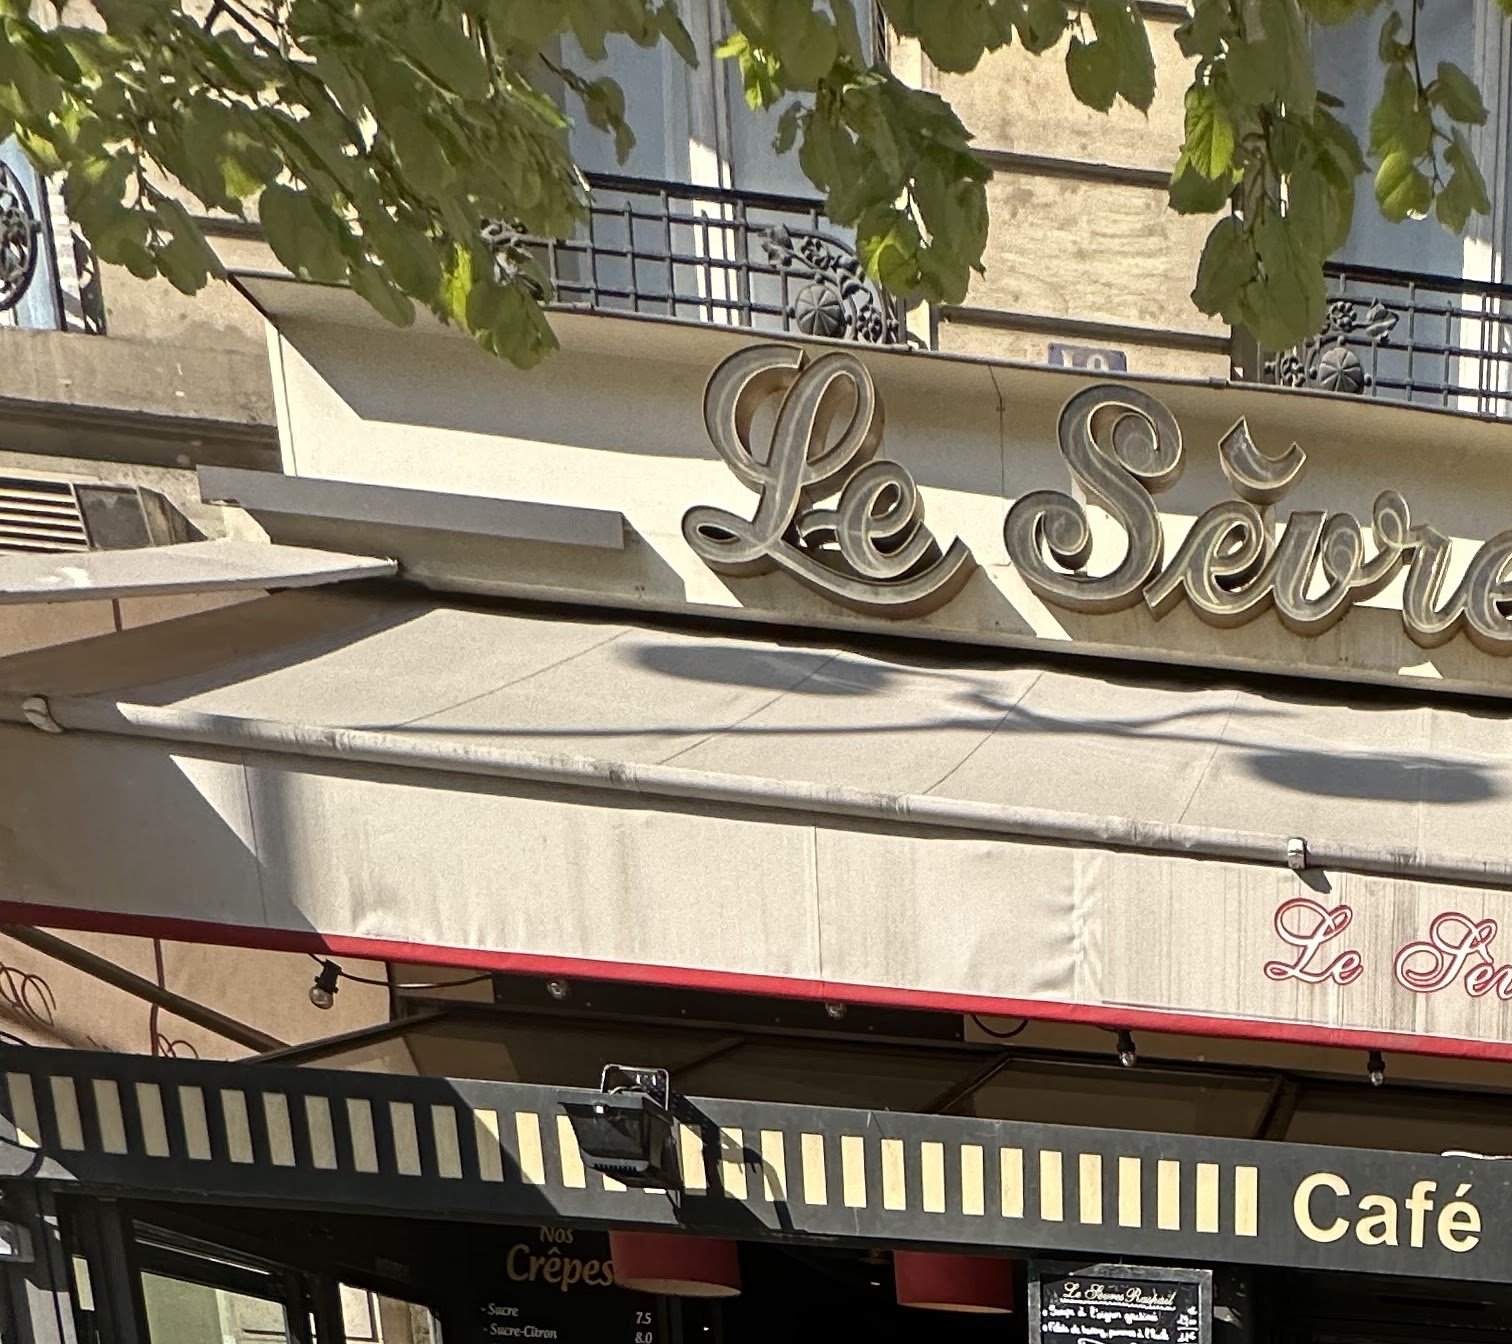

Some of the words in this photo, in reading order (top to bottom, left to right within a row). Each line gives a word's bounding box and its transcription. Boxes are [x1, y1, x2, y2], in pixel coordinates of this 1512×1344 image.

[681, 344, 972, 620] Le
[1264, 897, 1363, 986] Le
[540, 1225, 575, 1245] Nos
[1292, 1171, 1483, 1254] Café
[506, 1243, 615, 1293] Crêpes
[488, 1303, 519, 1318] Sucre
[635, 1311, 652, 1325] 7.5
[490, 1323, 557, 1340] Sucre-Citron
[634, 1332, 653, 1344] 8.0
